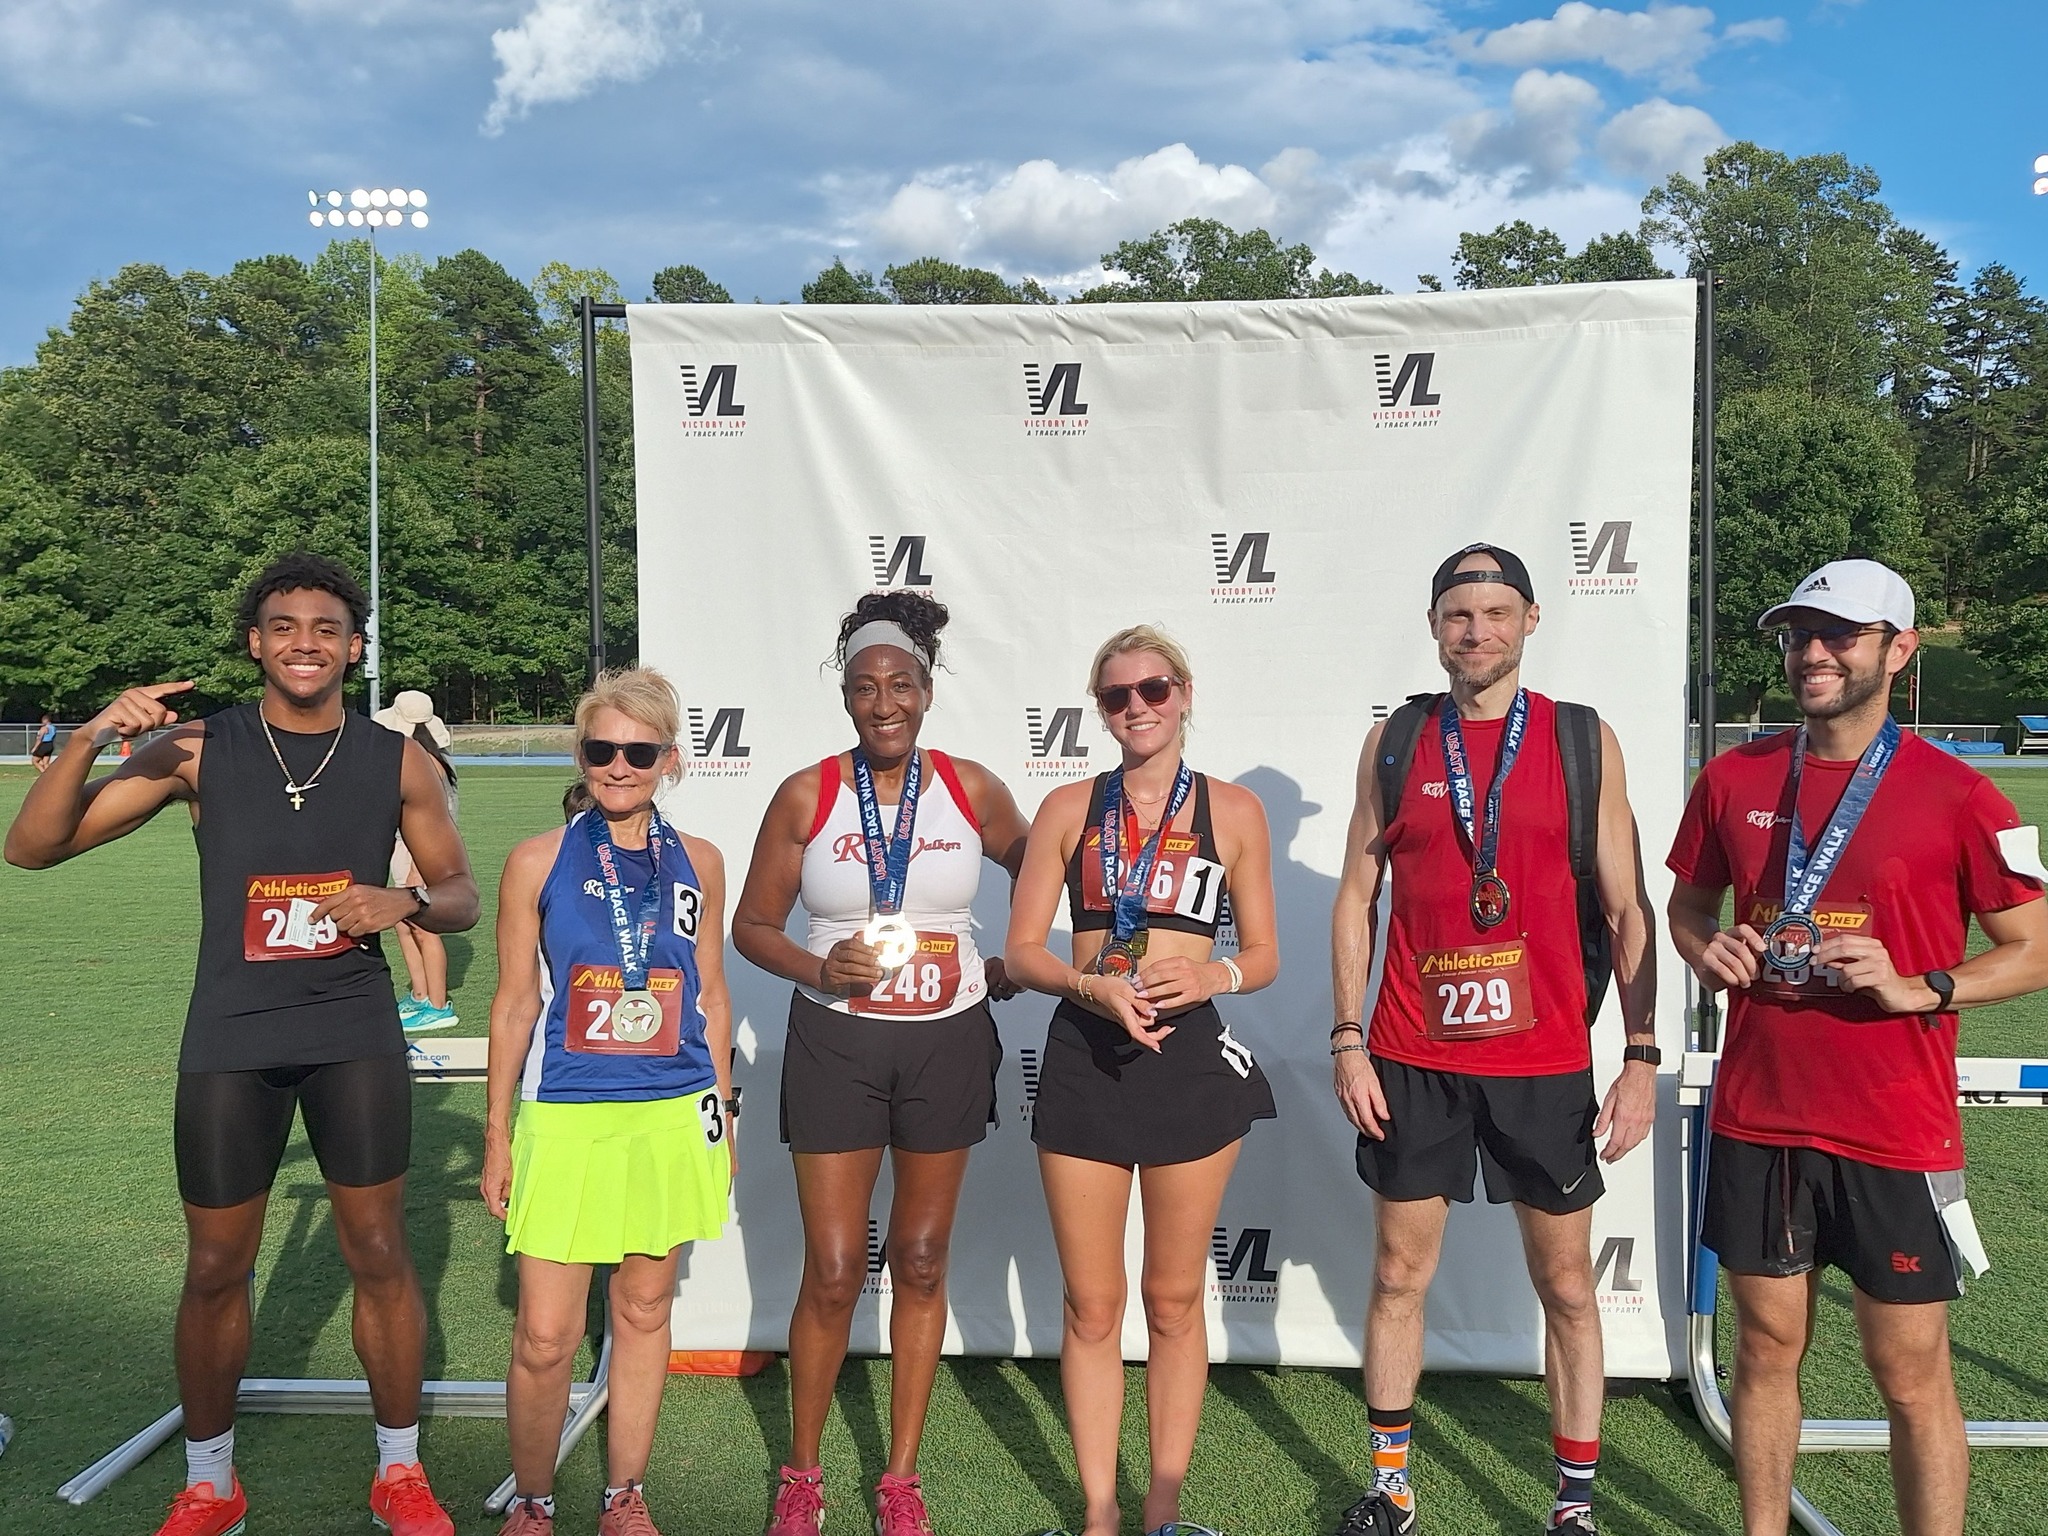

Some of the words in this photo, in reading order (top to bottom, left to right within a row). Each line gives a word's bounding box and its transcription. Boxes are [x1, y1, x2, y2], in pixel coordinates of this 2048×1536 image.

[1024, 420, 1066, 428] VICTORY
[1373, 411, 1416, 420] VICTORY
[1423, 410, 1441, 418] LAP
[1259, 587, 1276, 595] LAP
[1569, 579, 1613, 587] VICTORY
[1620, 578, 1639, 586] LAP
[1803, 585, 1831, 593] adidas
[1508, 712, 1524, 751] WALK
[1446, 732, 1465, 776] USATF
[1868, 741, 1885, 768] USATF
[857, 763, 873, 801] WALK
[1455, 778, 1471, 818] RACE
[864, 802, 879, 837] RACE
[898, 800, 914, 840] USATF
[906, 767, 918, 799] RACE
[1104, 809, 1116, 853] USATF
[870, 839, 888, 881] USATF
[1105, 857, 1117, 897] RACE
[1133, 861, 1146, 885] USATF
[1792, 873, 1823, 914] RACE
[1813, 825, 1848, 871] WALK
[598, 843, 618, 886] USATF
[609, 889, 628, 927] RACE
[619, 928, 638, 974] WALK
[888, 880, 898, 902] USATF
[1193, 866, 1212, 915] 1
[262, 908, 338, 947] 29
[678, 890, 698, 936] 3
[639, 933, 650, 959] USATF
[870, 963, 941, 1003] 248
[1438, 978, 1512, 1025] 229
[702, 1093, 723, 1143] 3
[1211, 1285, 1253, 1293] VICTORY
